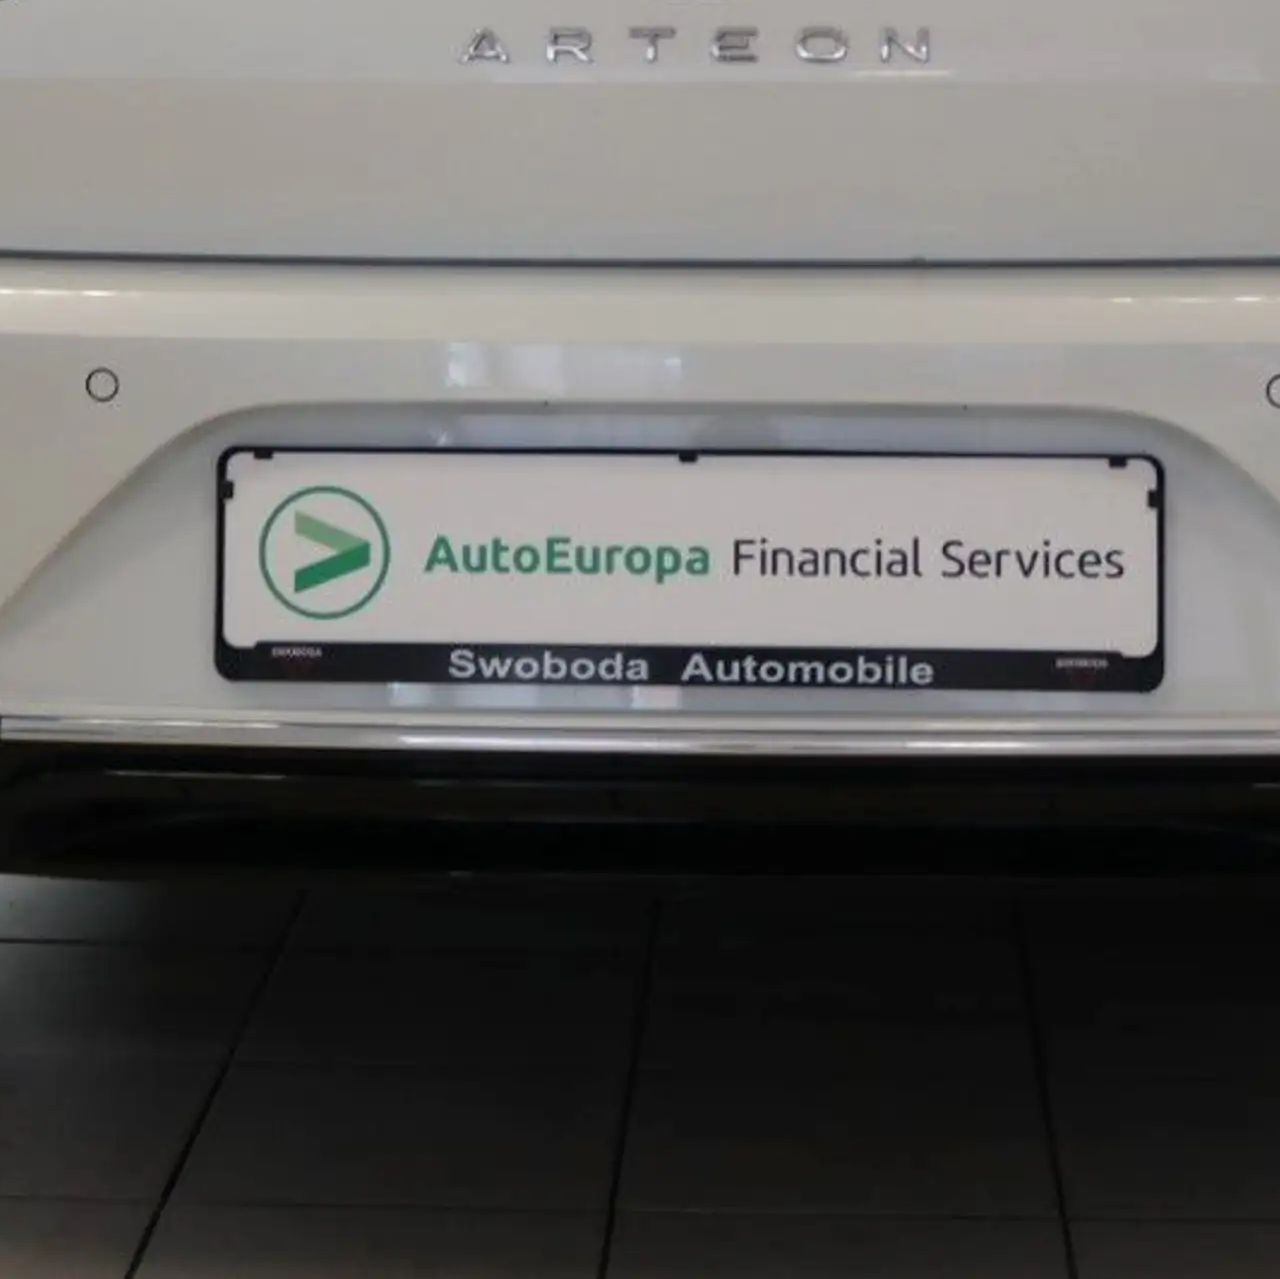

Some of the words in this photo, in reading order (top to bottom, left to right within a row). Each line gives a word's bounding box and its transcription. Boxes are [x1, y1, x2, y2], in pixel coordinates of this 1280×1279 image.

[460, 26, 932, 64] ARTEON
[423, 534, 711, 584] AutoEuropa
[731, 538, 924, 578] Financial
[939, 539, 1126, 580] Services
[448, 648, 650, 681] Swoboda
[681, 653, 935, 686] Automobile
